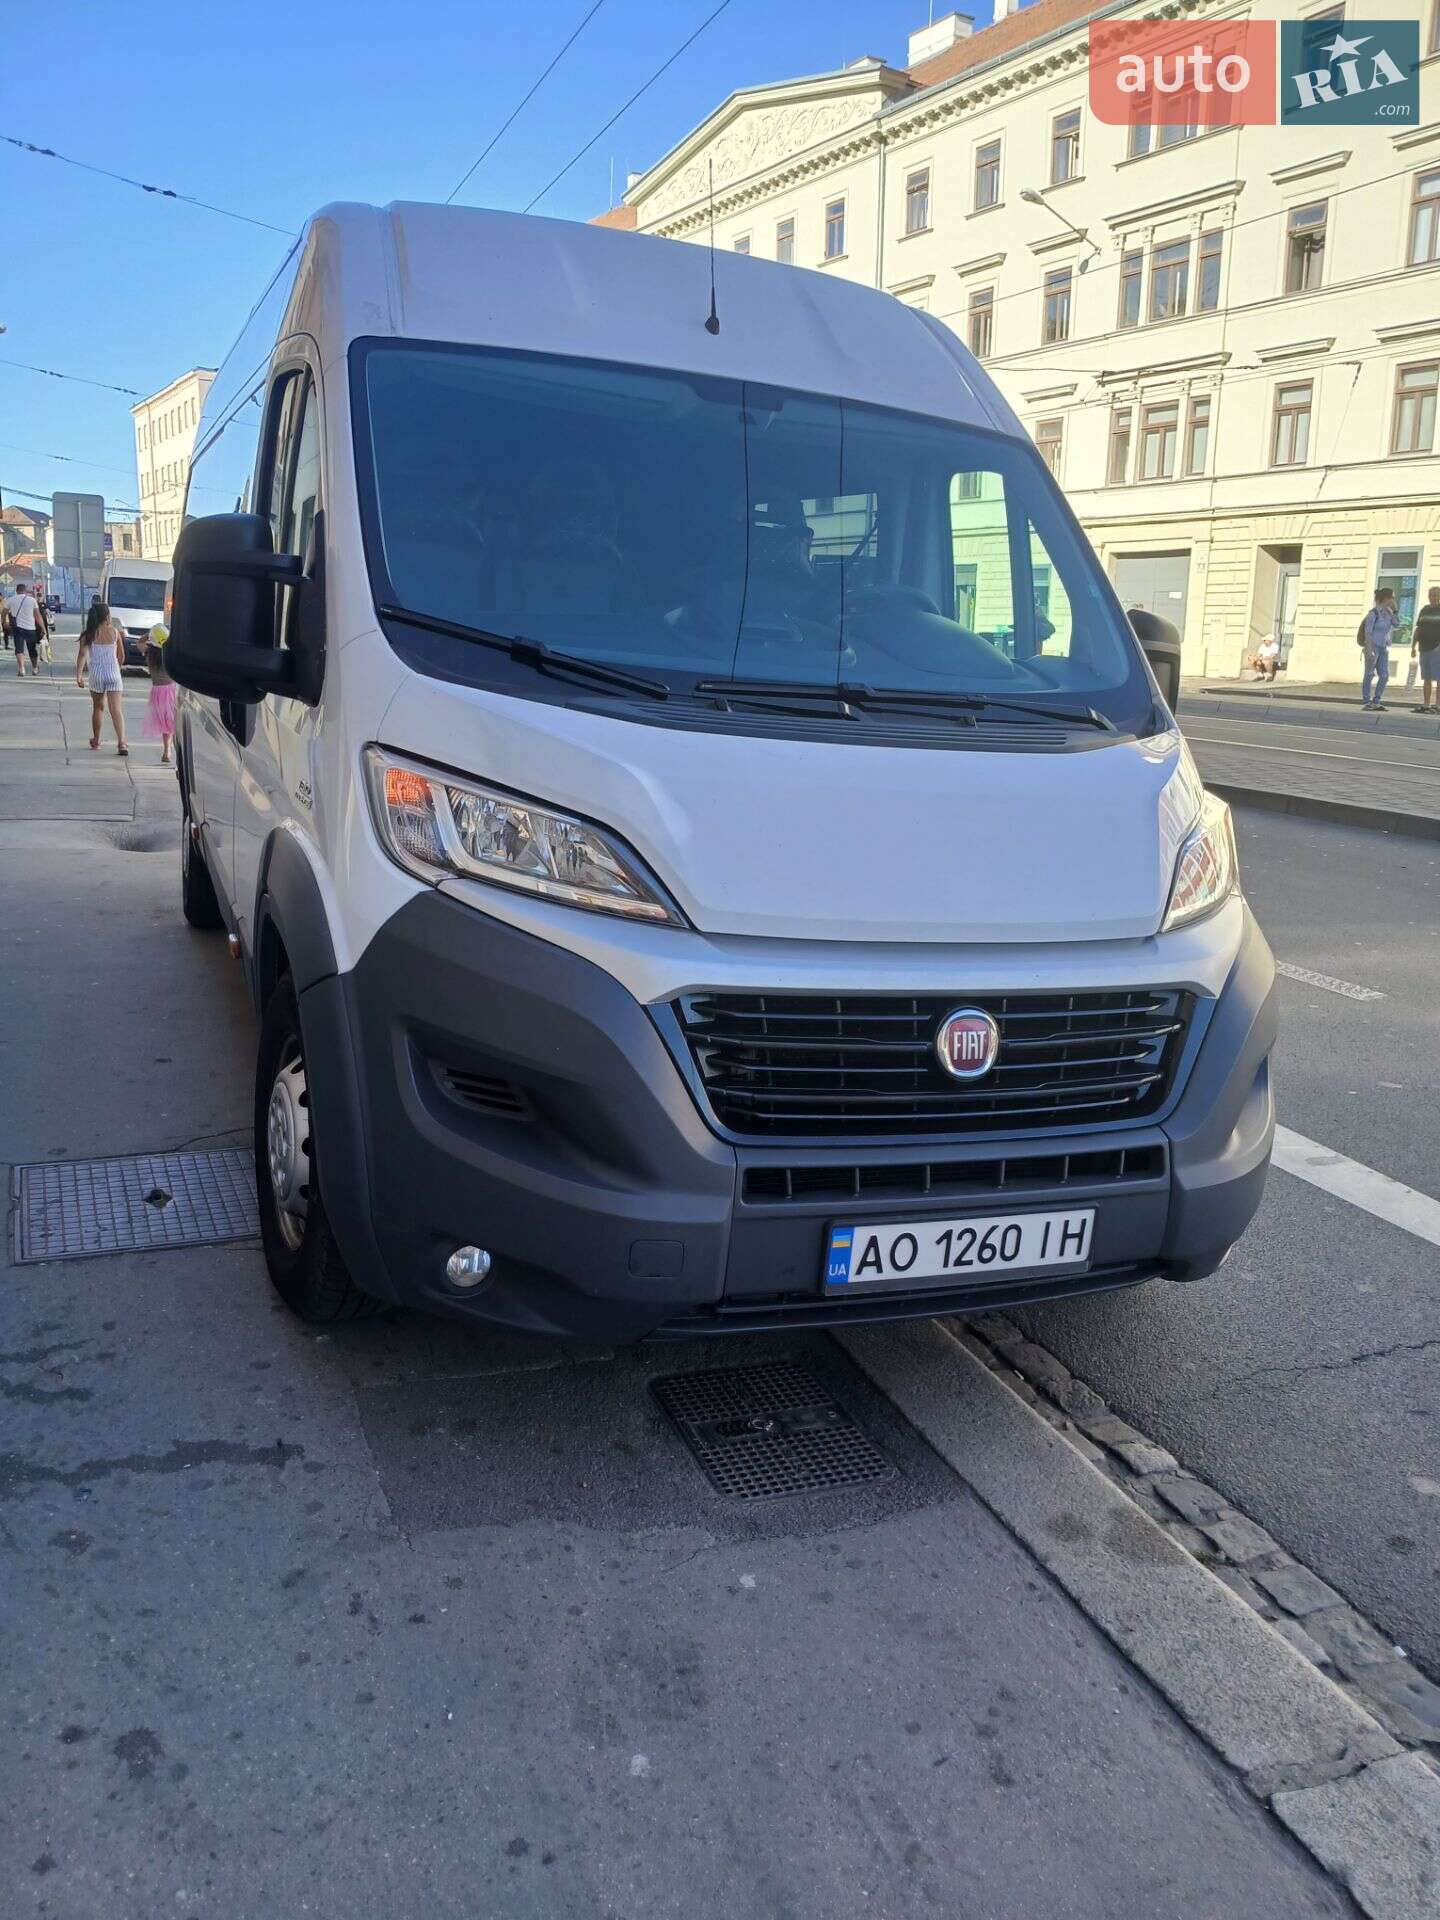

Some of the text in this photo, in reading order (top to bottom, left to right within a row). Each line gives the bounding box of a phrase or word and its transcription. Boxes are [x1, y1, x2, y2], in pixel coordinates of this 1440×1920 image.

[953, 1031, 986, 1060] FIAT
[855, 1218, 1087, 1275] AO 1260 IH
[829, 1263, 847, 1276] UA
